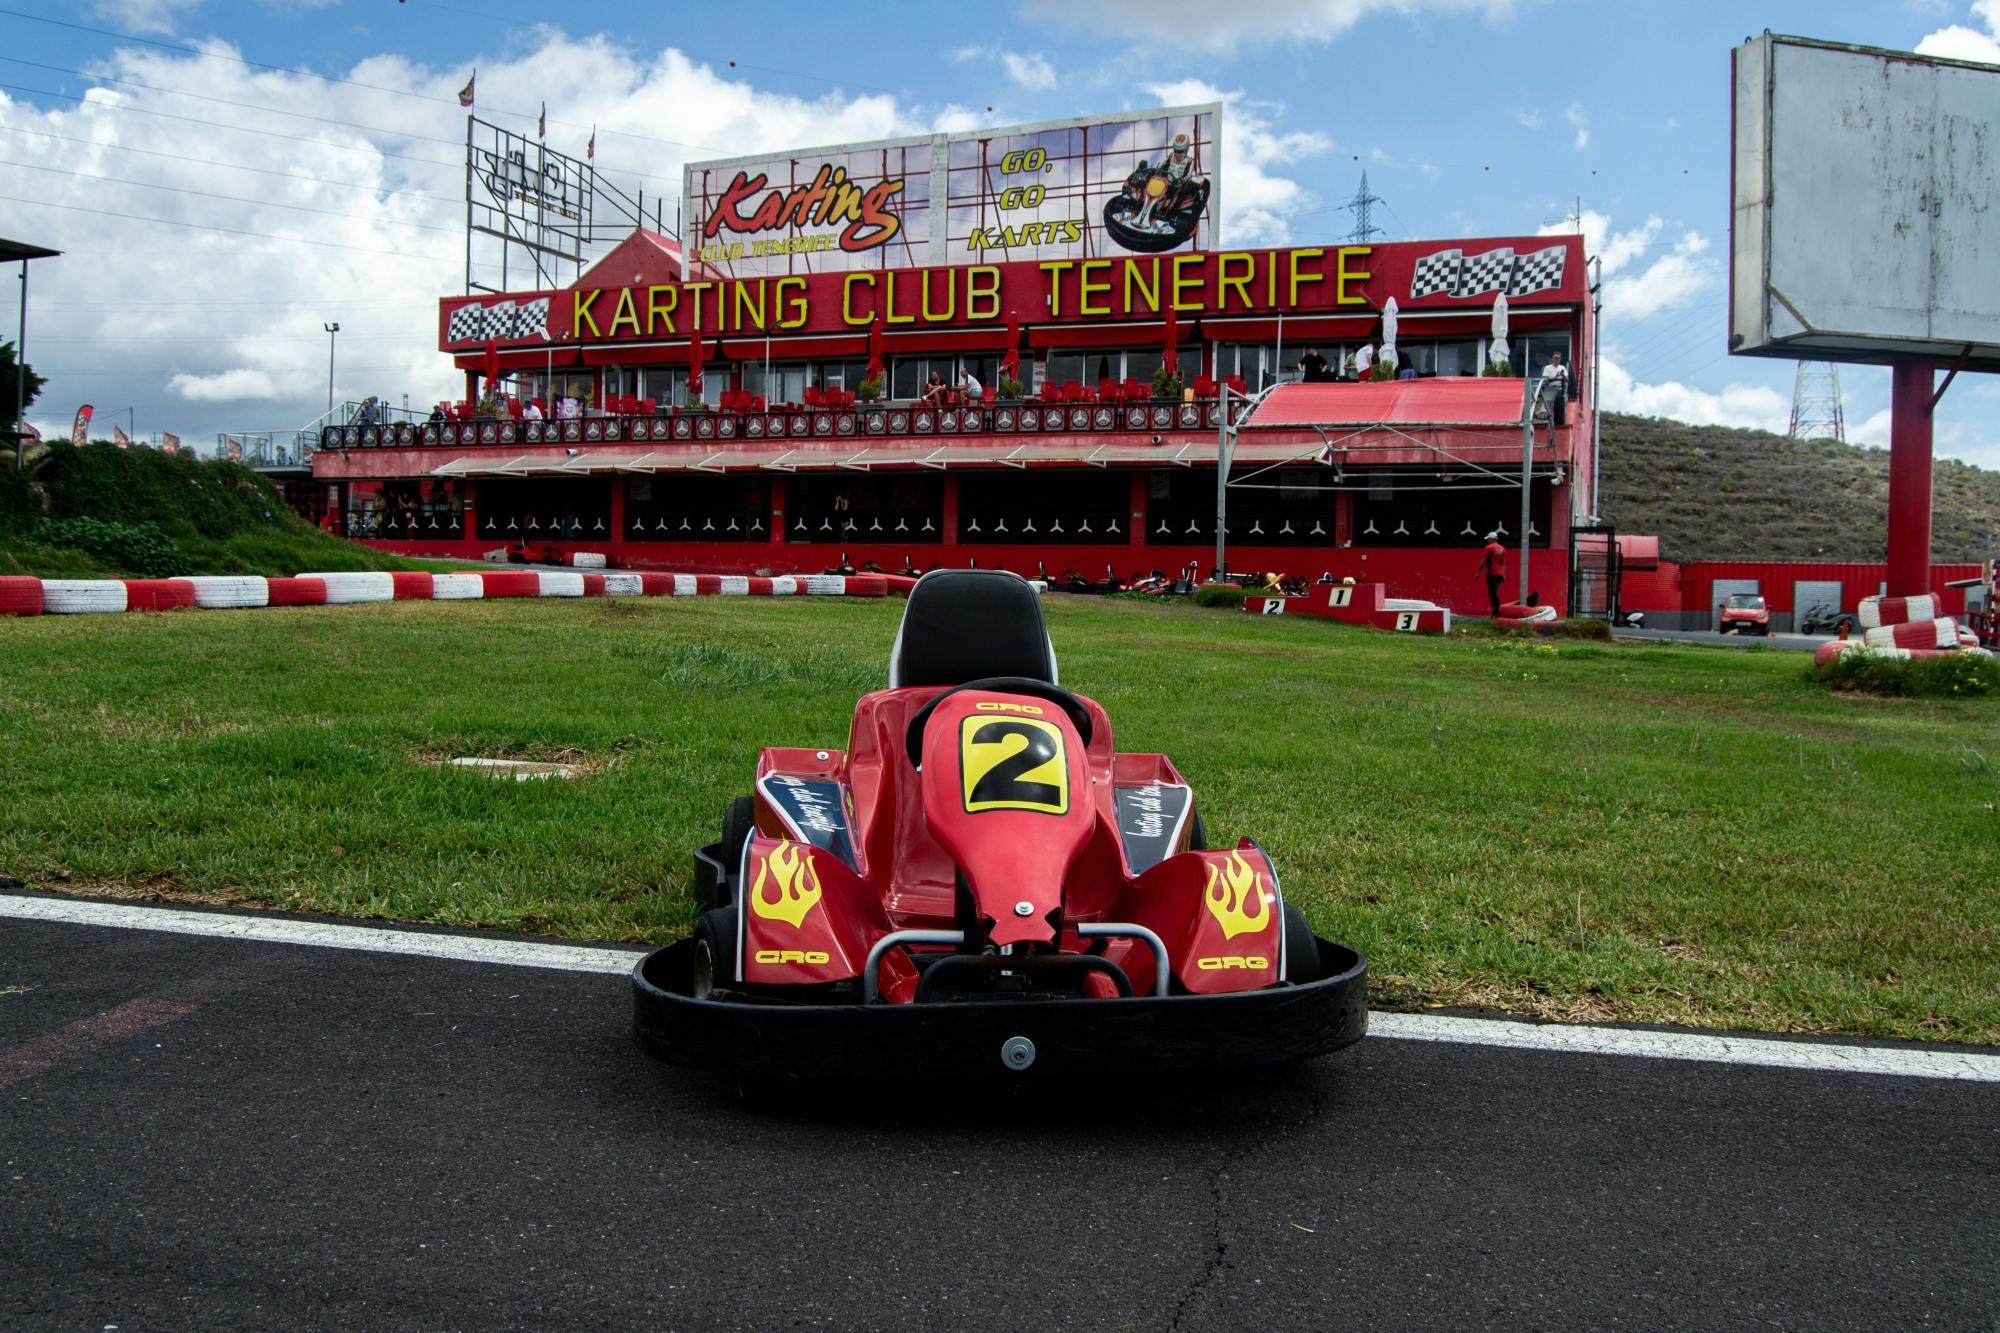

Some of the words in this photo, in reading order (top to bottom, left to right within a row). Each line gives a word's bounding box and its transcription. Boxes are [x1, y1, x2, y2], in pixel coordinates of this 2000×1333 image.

[1000, 147, 1053, 175] GO,
[703, 162, 905, 252] Karting
[999, 184, 1046, 210] GO
[700, 241, 744, 262] CLUB
[752, 233, 838, 257] TENERIFE
[966, 219, 1085, 251] KARTS
[573, 276, 808, 338] KARTING
[843, 266, 1001, 325] CLUB
[1039, 247, 1372, 316] TENERIFE
[1267, 600, 1280, 615] 2
[1335, 589, 1345, 605] 1
[1400, 614, 1414, 630] 3
[976, 702, 1044, 715] CRG
[969, 721, 1061, 808] 2
[755, 950, 830, 964] CRG
[1197, 956, 1268, 970] CRG
